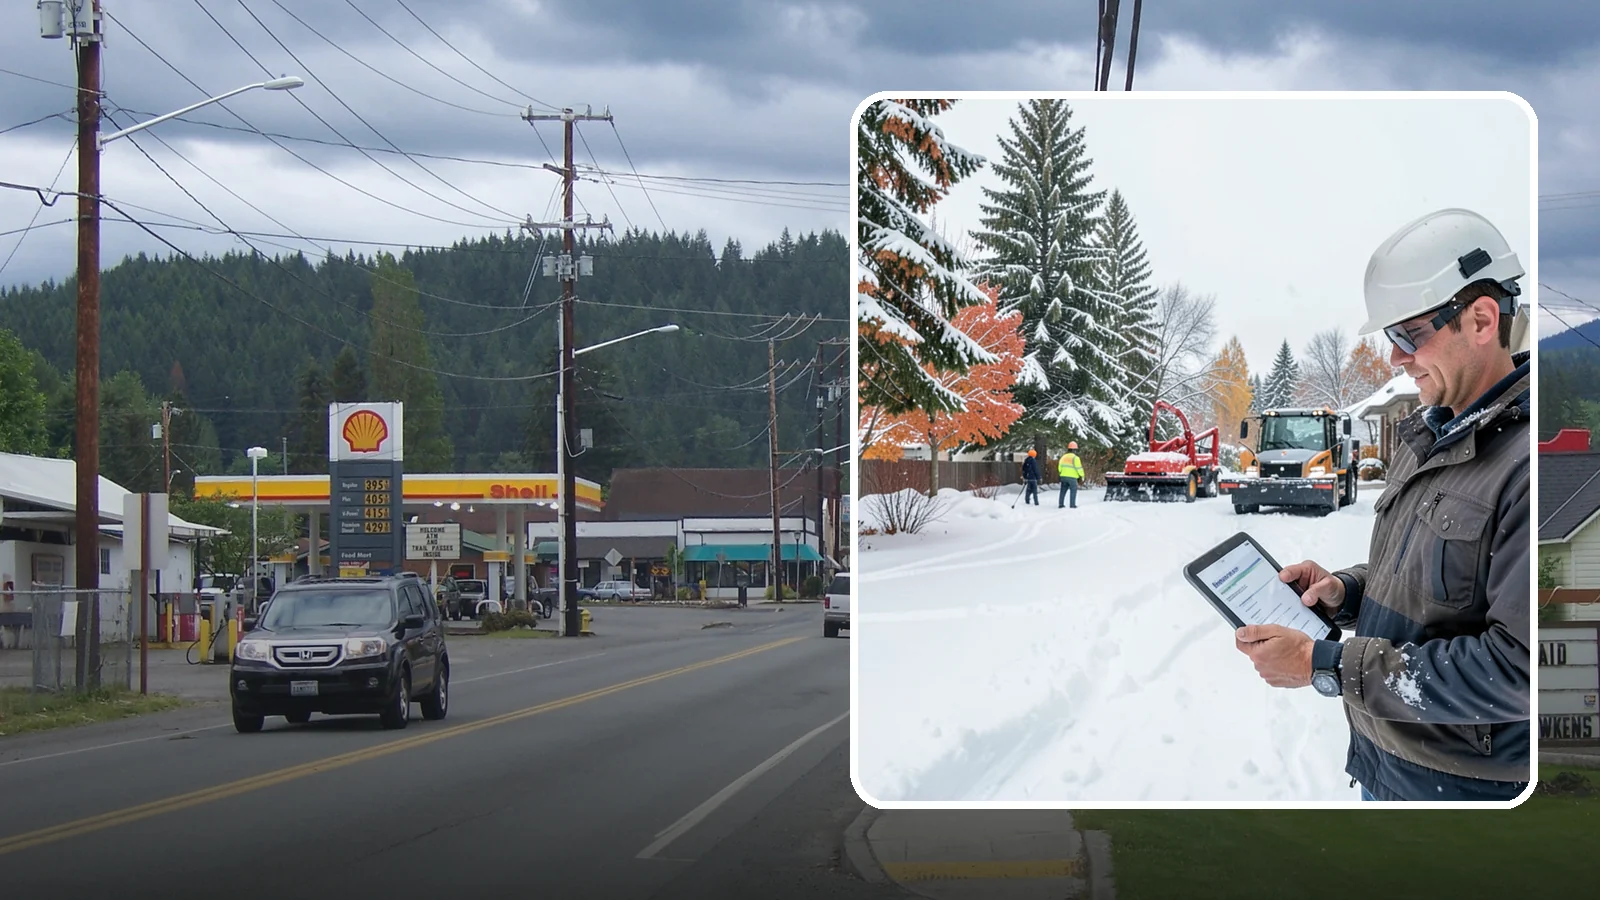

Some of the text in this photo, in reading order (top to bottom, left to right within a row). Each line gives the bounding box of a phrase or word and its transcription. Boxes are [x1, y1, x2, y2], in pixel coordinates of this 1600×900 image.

[490, 484, 547, 499] Shell
[365, 494, 383, 504] 405
[365, 508, 383, 518] 415
[365, 522, 383, 532] 429
[1538, 642, 1567, 665] AID
